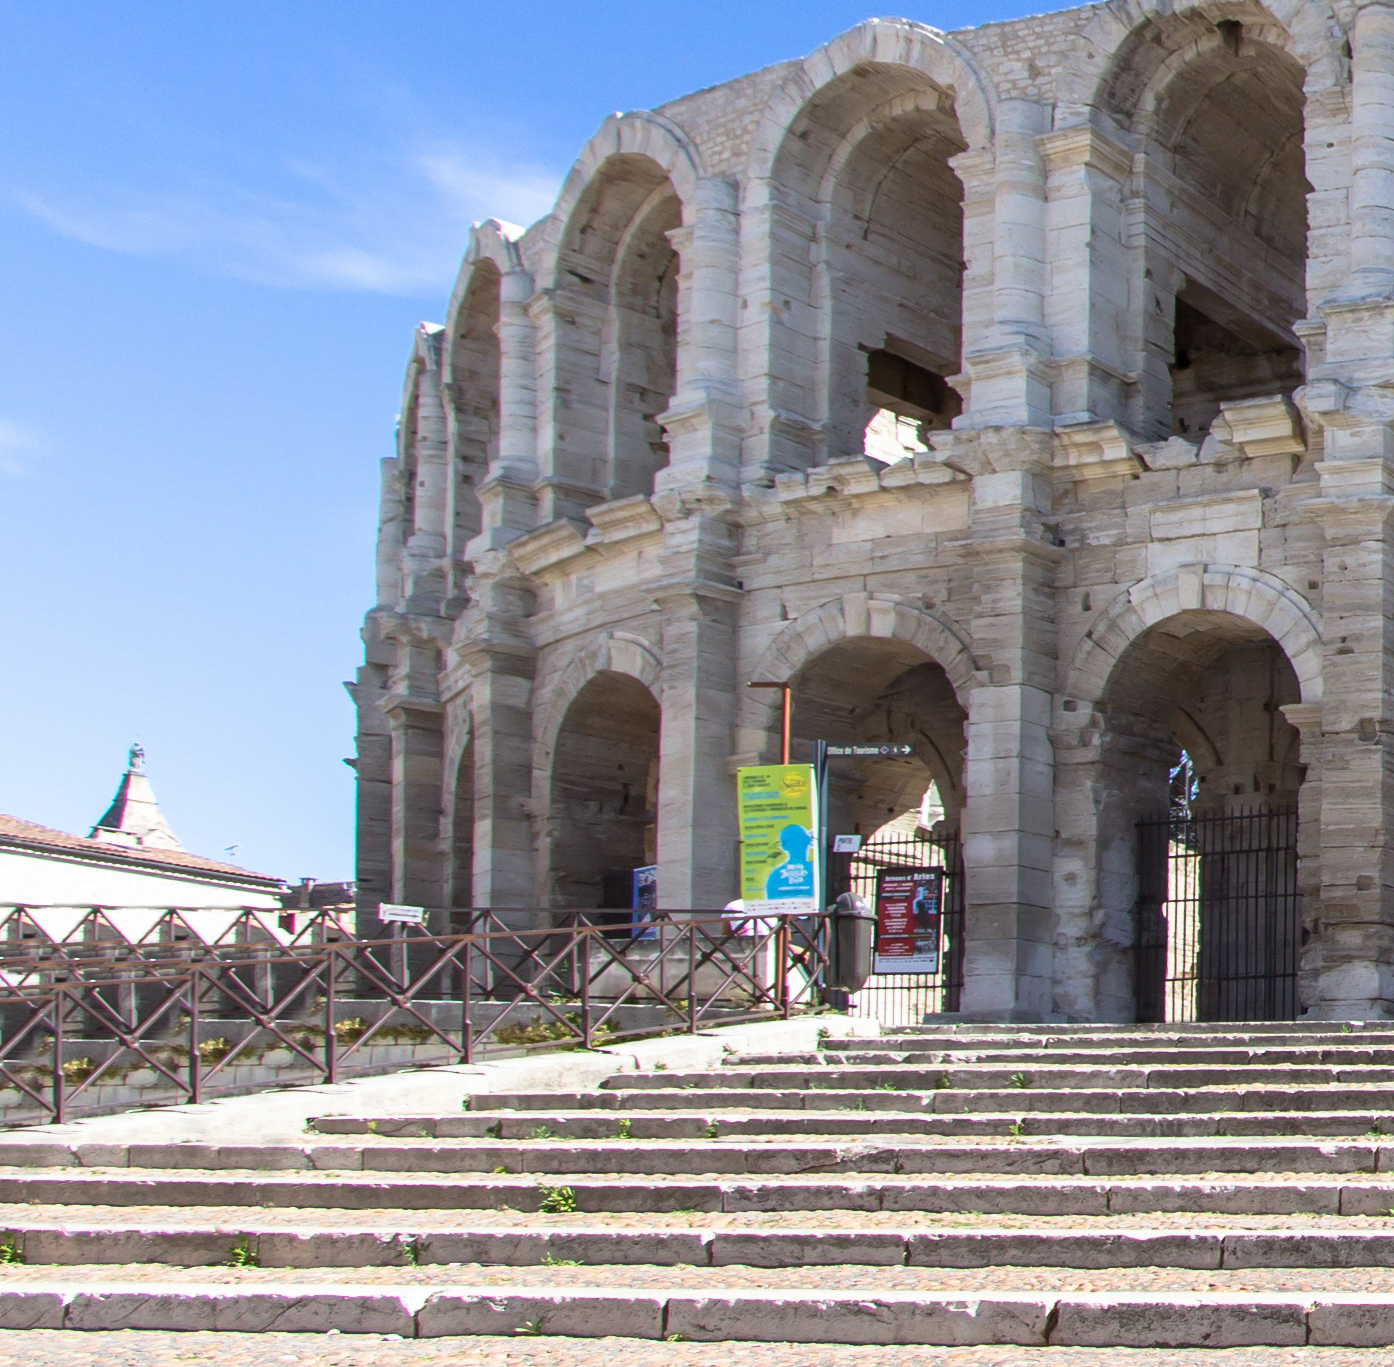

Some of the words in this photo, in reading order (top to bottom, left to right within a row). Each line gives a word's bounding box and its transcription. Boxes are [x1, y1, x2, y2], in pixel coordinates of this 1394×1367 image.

[827, 746, 844, 754] Office
[844, 746, 852, 754] de
[852, 746, 879, 754] Tourisme
